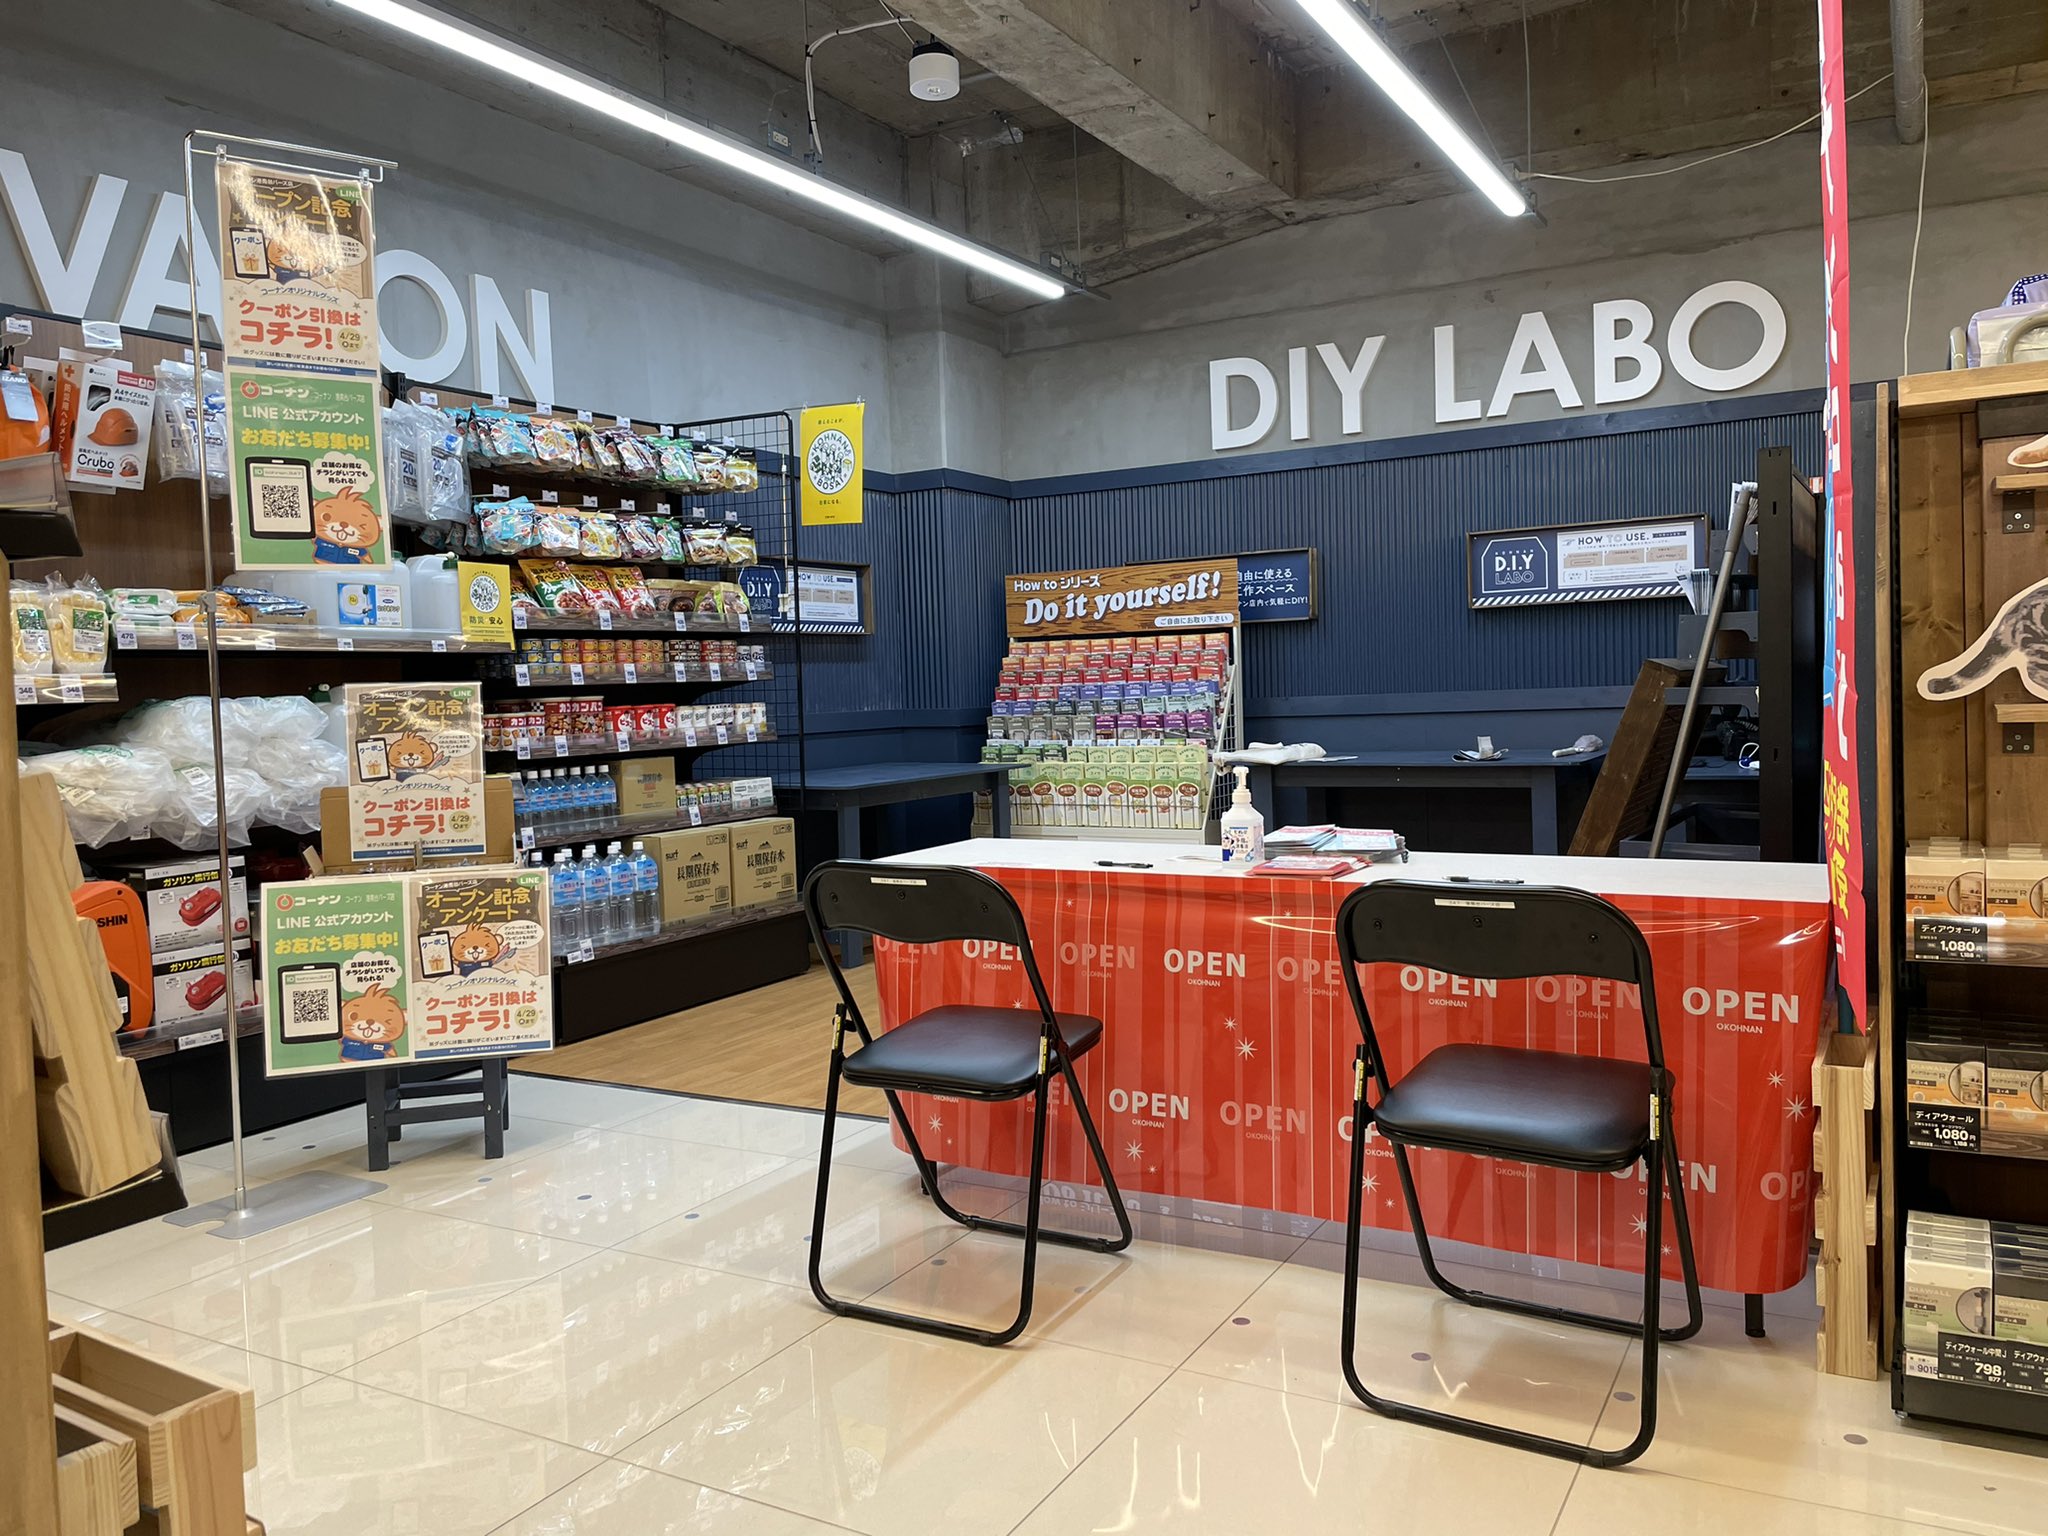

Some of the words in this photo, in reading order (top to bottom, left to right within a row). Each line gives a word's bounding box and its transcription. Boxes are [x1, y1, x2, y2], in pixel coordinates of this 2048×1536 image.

[340, 190, 361, 199] LINE
[255, 190, 352, 218] ープン記念
[234, 236, 263, 245] クーポン
[261, 287, 340, 304] コーナンオリジナルグッズ
[239, 299, 362, 327] クーポン引換は
[240, 319, 334, 350] コチラ!
[340, 332, 360, 342] 4/29
[1209, 335, 1386, 452] DIY
[1434, 280, 1787, 423] LABO
[260, 386, 310, 398] コーナン
[242, 406, 279, 420] LINE
[282, 408, 365, 424] 公式アカウント
[241, 427, 371, 450] お友だち募集中!
[77, 454, 115, 470] Crubo
[321, 461, 362, 470] 店舗のお得な
[316, 469, 368, 478] チラシがいつでも
[328, 477, 357, 485] 見られる!
[816, 476, 845, 491] BOSAI
[1578, 535, 1603, 546] HOW
[1606, 533, 1622, 543] TO
[1626, 532, 1650, 542] USE.
[1495, 554, 1534, 571] D.I.Y
[1014, 579, 1041, 592] How
[1043, 579, 1058, 590] to
[1060, 573, 1101, 590] シリーズ
[1495, 570, 1535, 584] LABO
[746, 580, 772, 597] D.I.Y
[1024, 597, 1060, 625] Do
[1065, 592, 1087, 617] it
[1093, 570, 1222, 620] yourself!
[1160, 614, 1228, 626] ご自由にお取り下さい
[120, 632, 134, 640] 478
[18, 686, 33, 695] 348
[453, 689, 472, 697] LINE
[359, 744, 385, 754] クーポン
[382, 783, 452, 795] コーナンオリジナルグッズ
[363, 796, 471, 814] クーポン引換は
[364, 813, 445, 837] コチラ!
[451, 814, 470, 823] 4/29
[747, 849, 786, 868] 長期保存水
[677, 860, 720, 881] 長期保存水
[520, 877, 540, 885] LINE
[294, 895, 341, 906] コーナン
[426, 885, 531, 908] オープン記念
[95, 913, 128, 929] SHIN
[277, 916, 311, 930] LINE
[314, 911, 394, 928] 公式アカウント
[439, 905, 519, 925] アンケート
[1921, 925, 1981, 934] ディアウォール
[274, 931, 399, 955] お友だち募集中!
[422, 938, 448, 950] クーポン
[876, 934, 938, 956] OPEN
[1060, 941, 1135, 969] OPEN
[350, 960, 390, 968] 店舗のお得な
[983, 963, 1011, 972] OKOHNAN
[1163, 948, 1246, 978] OPEN
[345, 967, 396, 976] チラシがいつでも
[1081, 970, 1112, 979] OKOHNAN
[357, 975, 385, 983] 見られる!
[445, 978, 518, 991] コーナンオリジナルグッズ
[1187, 978, 1221, 988] OKOHNAN
[1400, 965, 1497, 998] OPEN
[1303, 987, 1339, 997] OKOHNAN
[1534, 975, 1641, 1010] OPEN
[425, 990, 537, 1011] クーポン引換は
[1428, 997, 1468, 1008] OKOHNAN
[1682, 986, 1799, 1024] OPEN
[516, 1009, 536, 1017] 4/29
[1566, 1009, 1609, 1021] OKOHNAN
[426, 1009, 510, 1035] コチラ!
[1716, 1022, 1764, 1034] OKOHNAN
[932, 1094, 960, 1104] OKOHNAN
[1108, 1087, 1190, 1121] OPEN
[1219, 1100, 1306, 1135] OPEN
[1915, 1110, 1974, 1123] ディアウォール
[1132, 1118, 1165, 1129] OKOHNAN
[1245, 1131, 1281, 1143] OKOHNAN
[1495, 1167, 1537, 1180] OKOHNAN
[1974, 1362, 2002, 1376] 798
